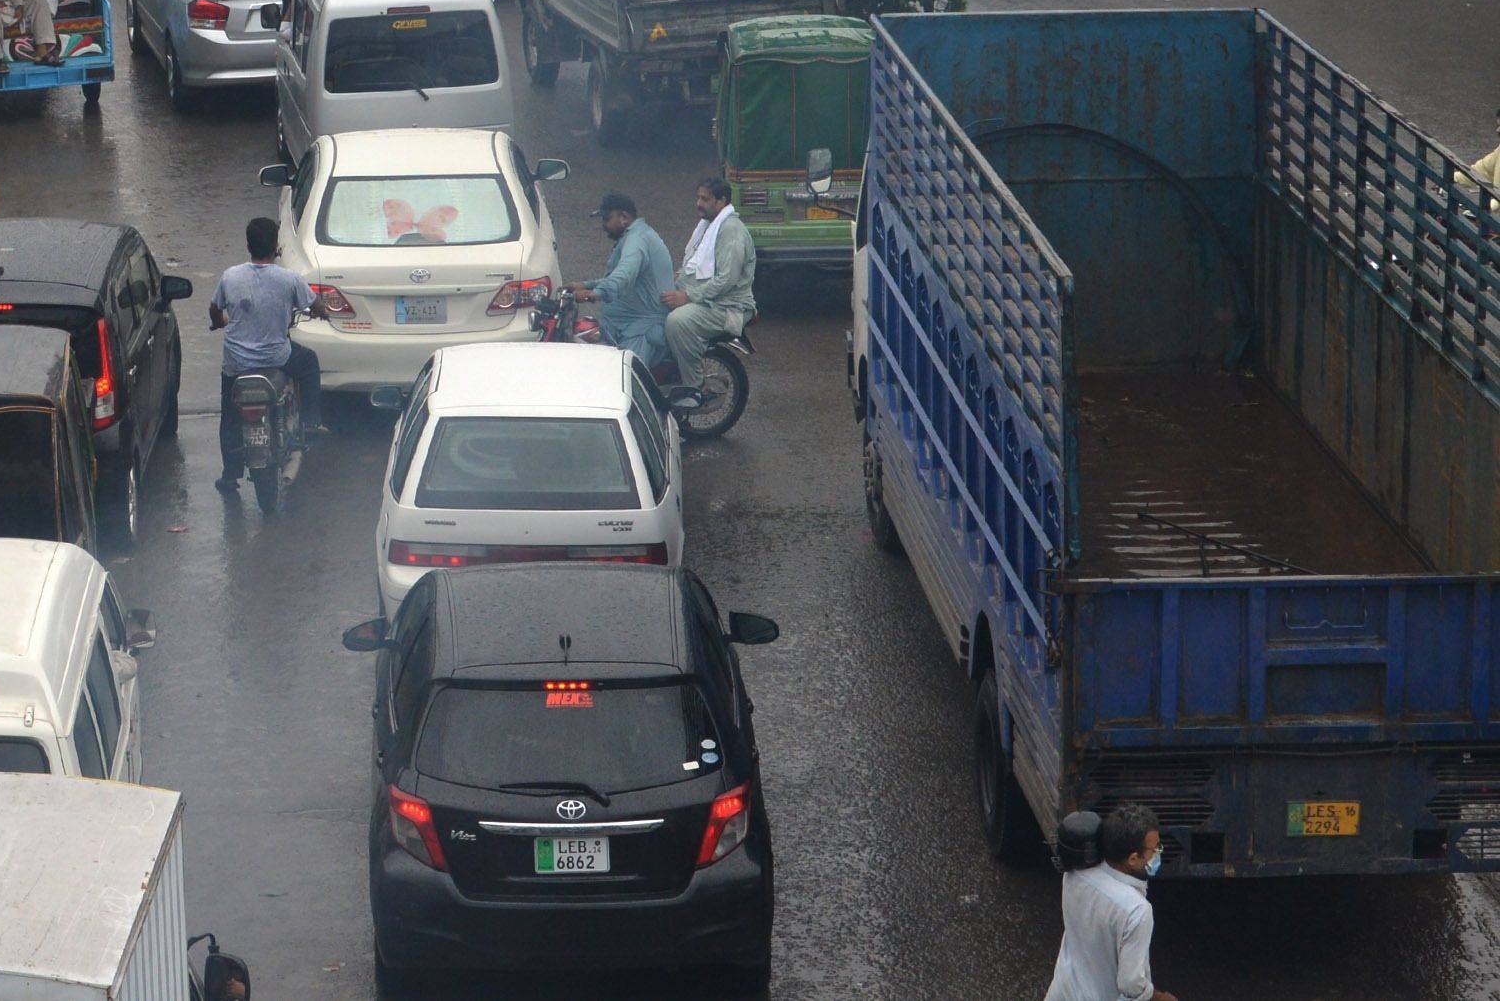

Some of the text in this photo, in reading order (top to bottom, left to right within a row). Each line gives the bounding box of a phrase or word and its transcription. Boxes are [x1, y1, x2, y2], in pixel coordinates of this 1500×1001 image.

[1305, 821, 1340, 834] 2294
[558, 840, 587, 854] LEB
[556, 855, 595, 870] 6862
